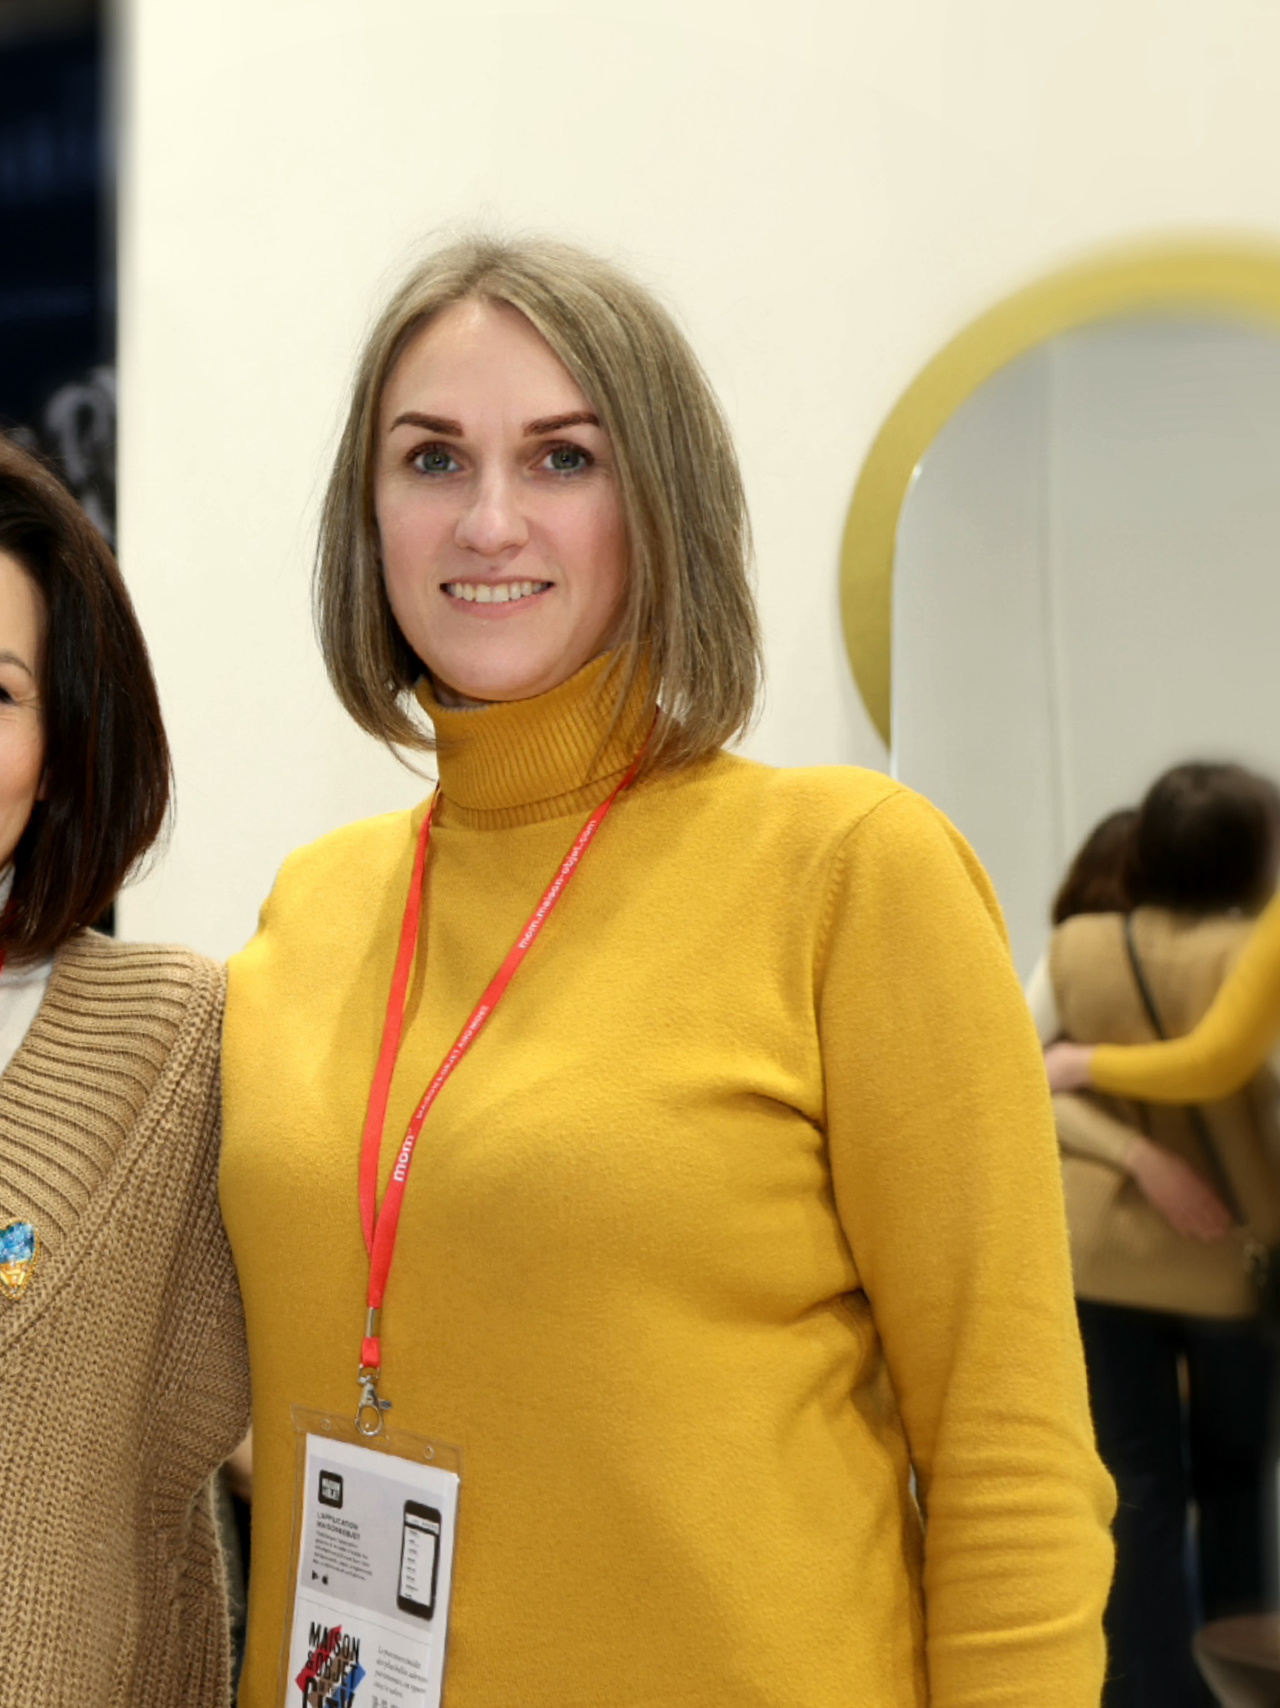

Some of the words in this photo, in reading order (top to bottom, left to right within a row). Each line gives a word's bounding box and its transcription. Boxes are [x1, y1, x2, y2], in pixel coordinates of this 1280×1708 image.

[518, 819, 596, 949] mom.maison-objet.com
[393, 1133, 414, 1182] mom
[308, 1621, 361, 1663] MAISON
